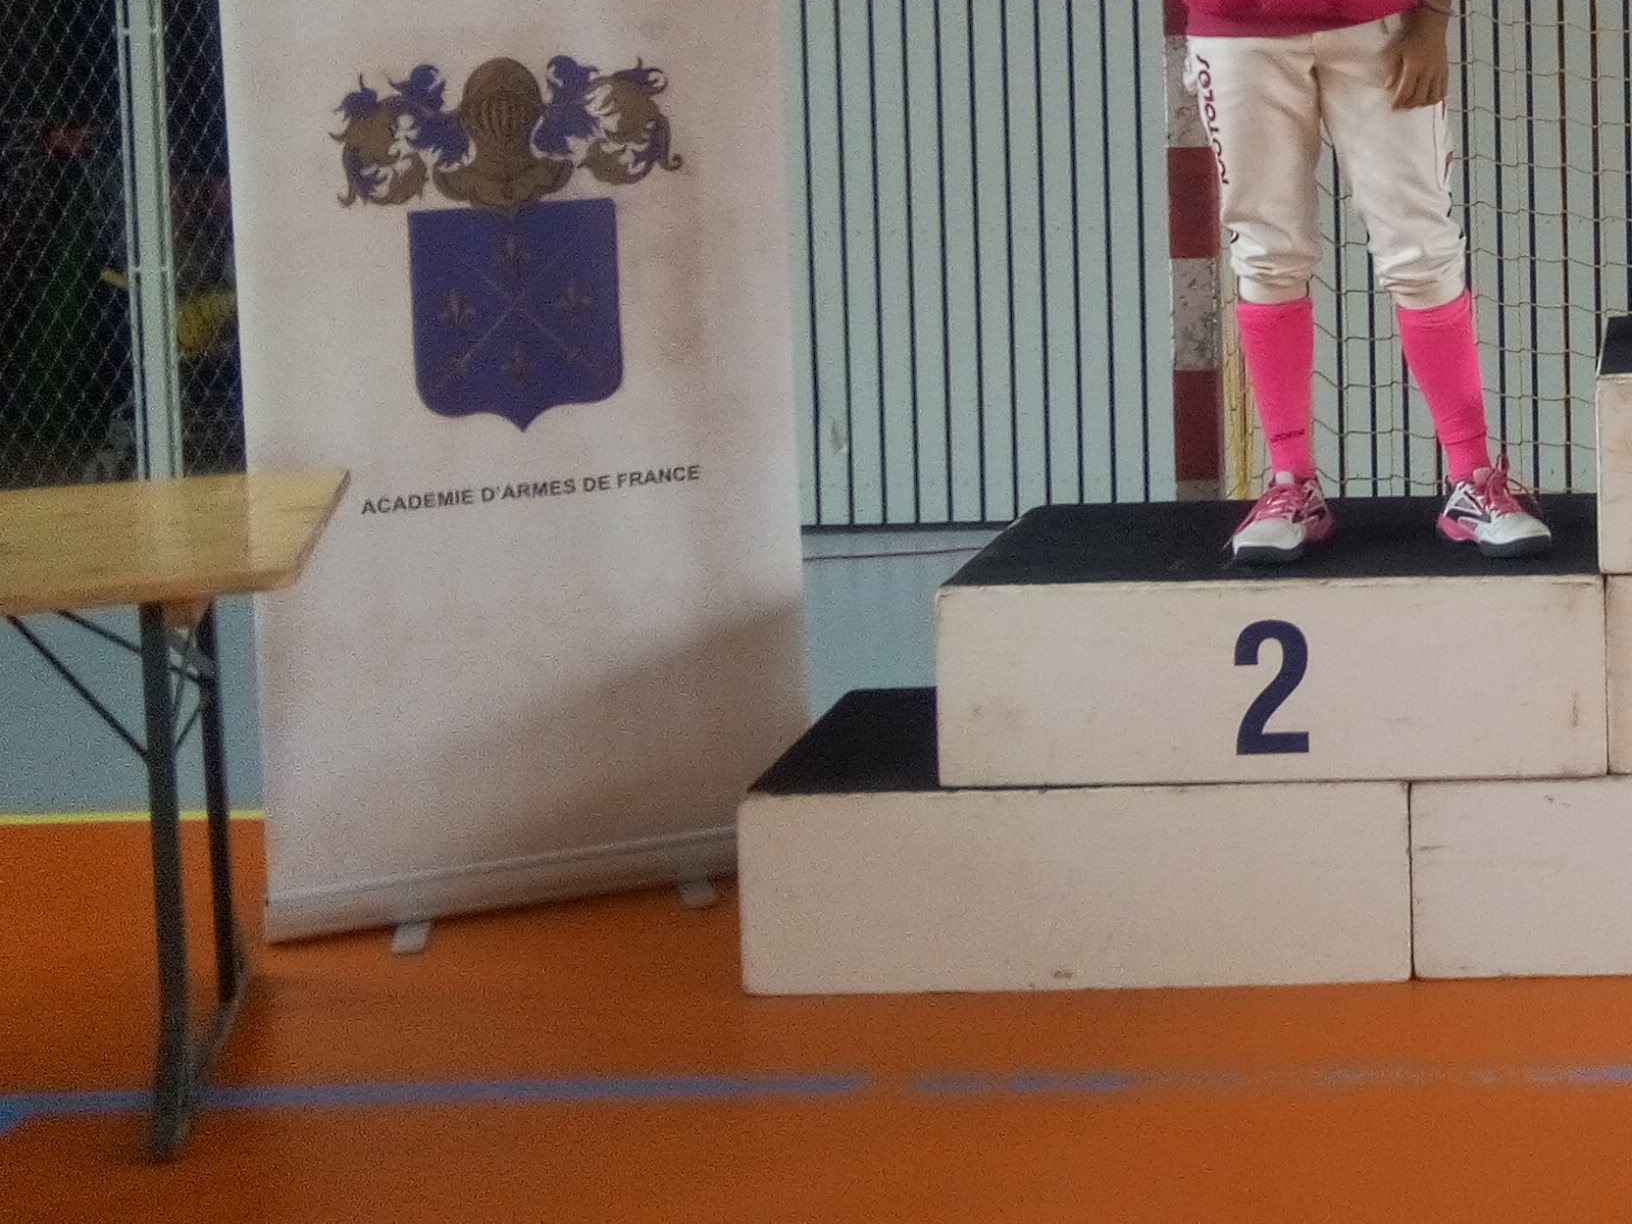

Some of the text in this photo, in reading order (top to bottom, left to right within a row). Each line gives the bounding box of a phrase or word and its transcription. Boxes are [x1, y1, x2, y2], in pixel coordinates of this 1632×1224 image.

[361, 465, 702, 515] ACADEMIE D'ARMES DE FRANCE
[1234, 619, 1309, 755] 2
